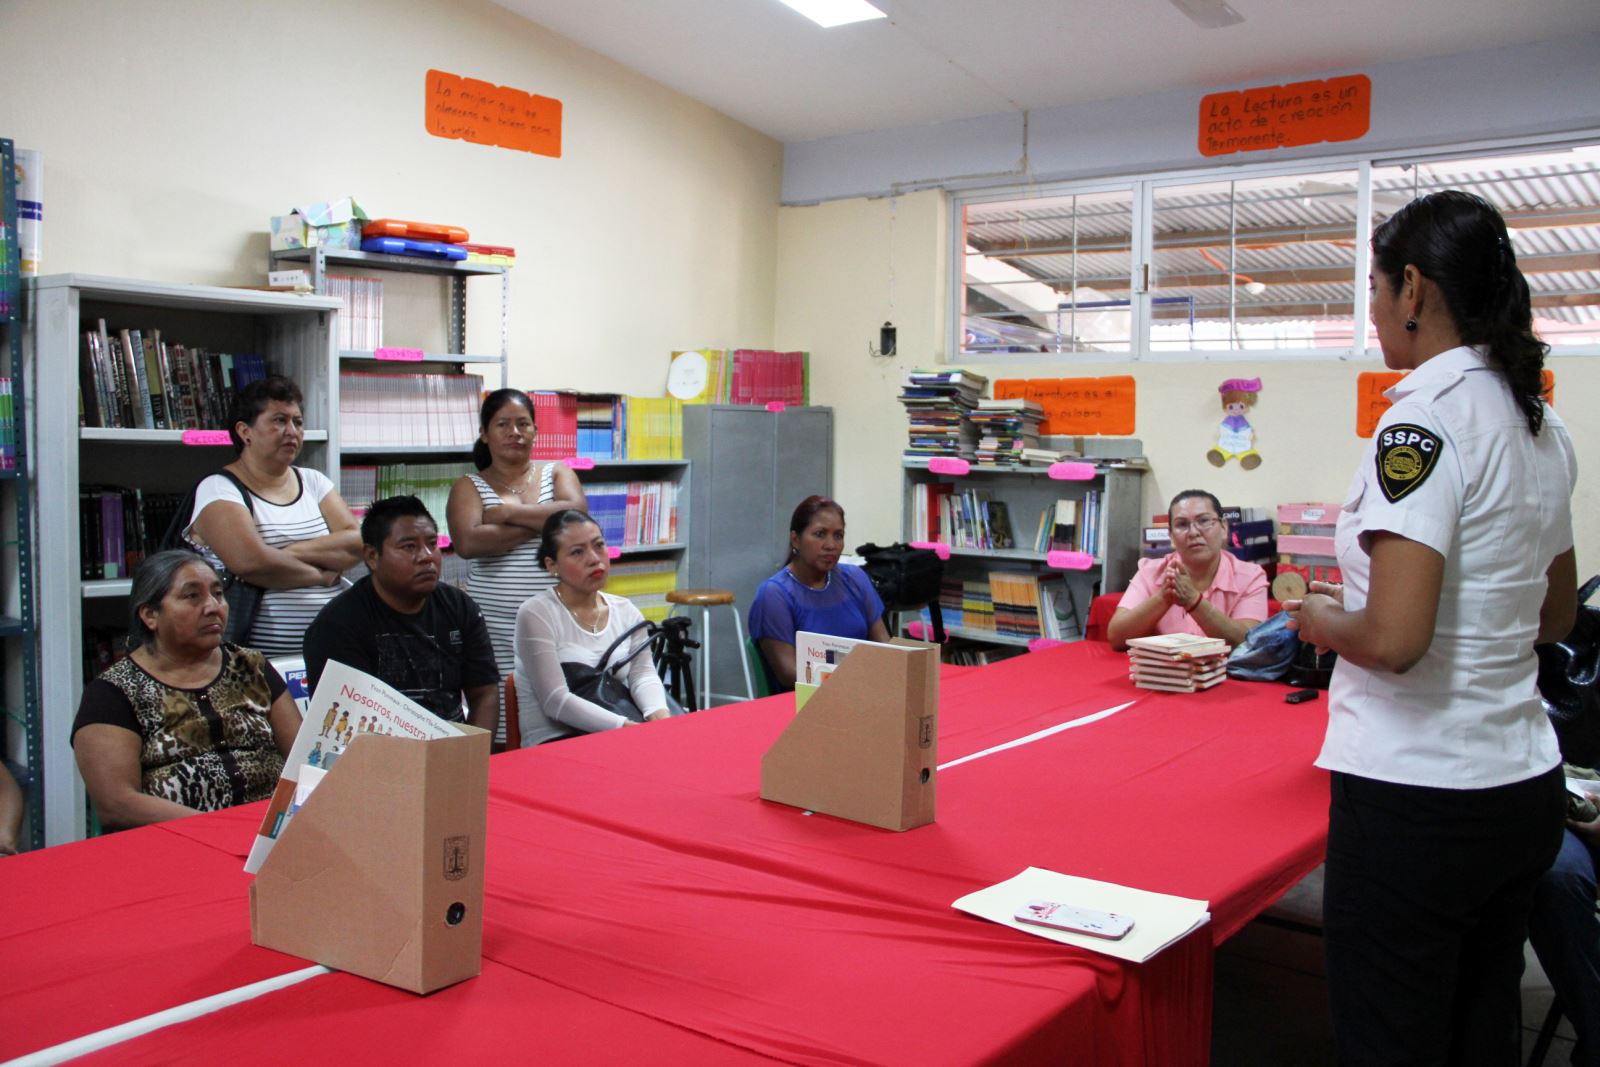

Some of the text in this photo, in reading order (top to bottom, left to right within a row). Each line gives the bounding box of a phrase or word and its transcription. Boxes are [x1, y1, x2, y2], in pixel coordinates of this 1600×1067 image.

[1210, 102, 1230, 117] La
[1311, 90, 1331, 102] es
[1339, 86, 1358, 99] un
[1208, 116, 1243, 134] acto
[1250, 115, 1268, 127] de
[1383, 431, 1435, 452] SSPC
[340, 684, 426, 740] Nosotros, nuestra
